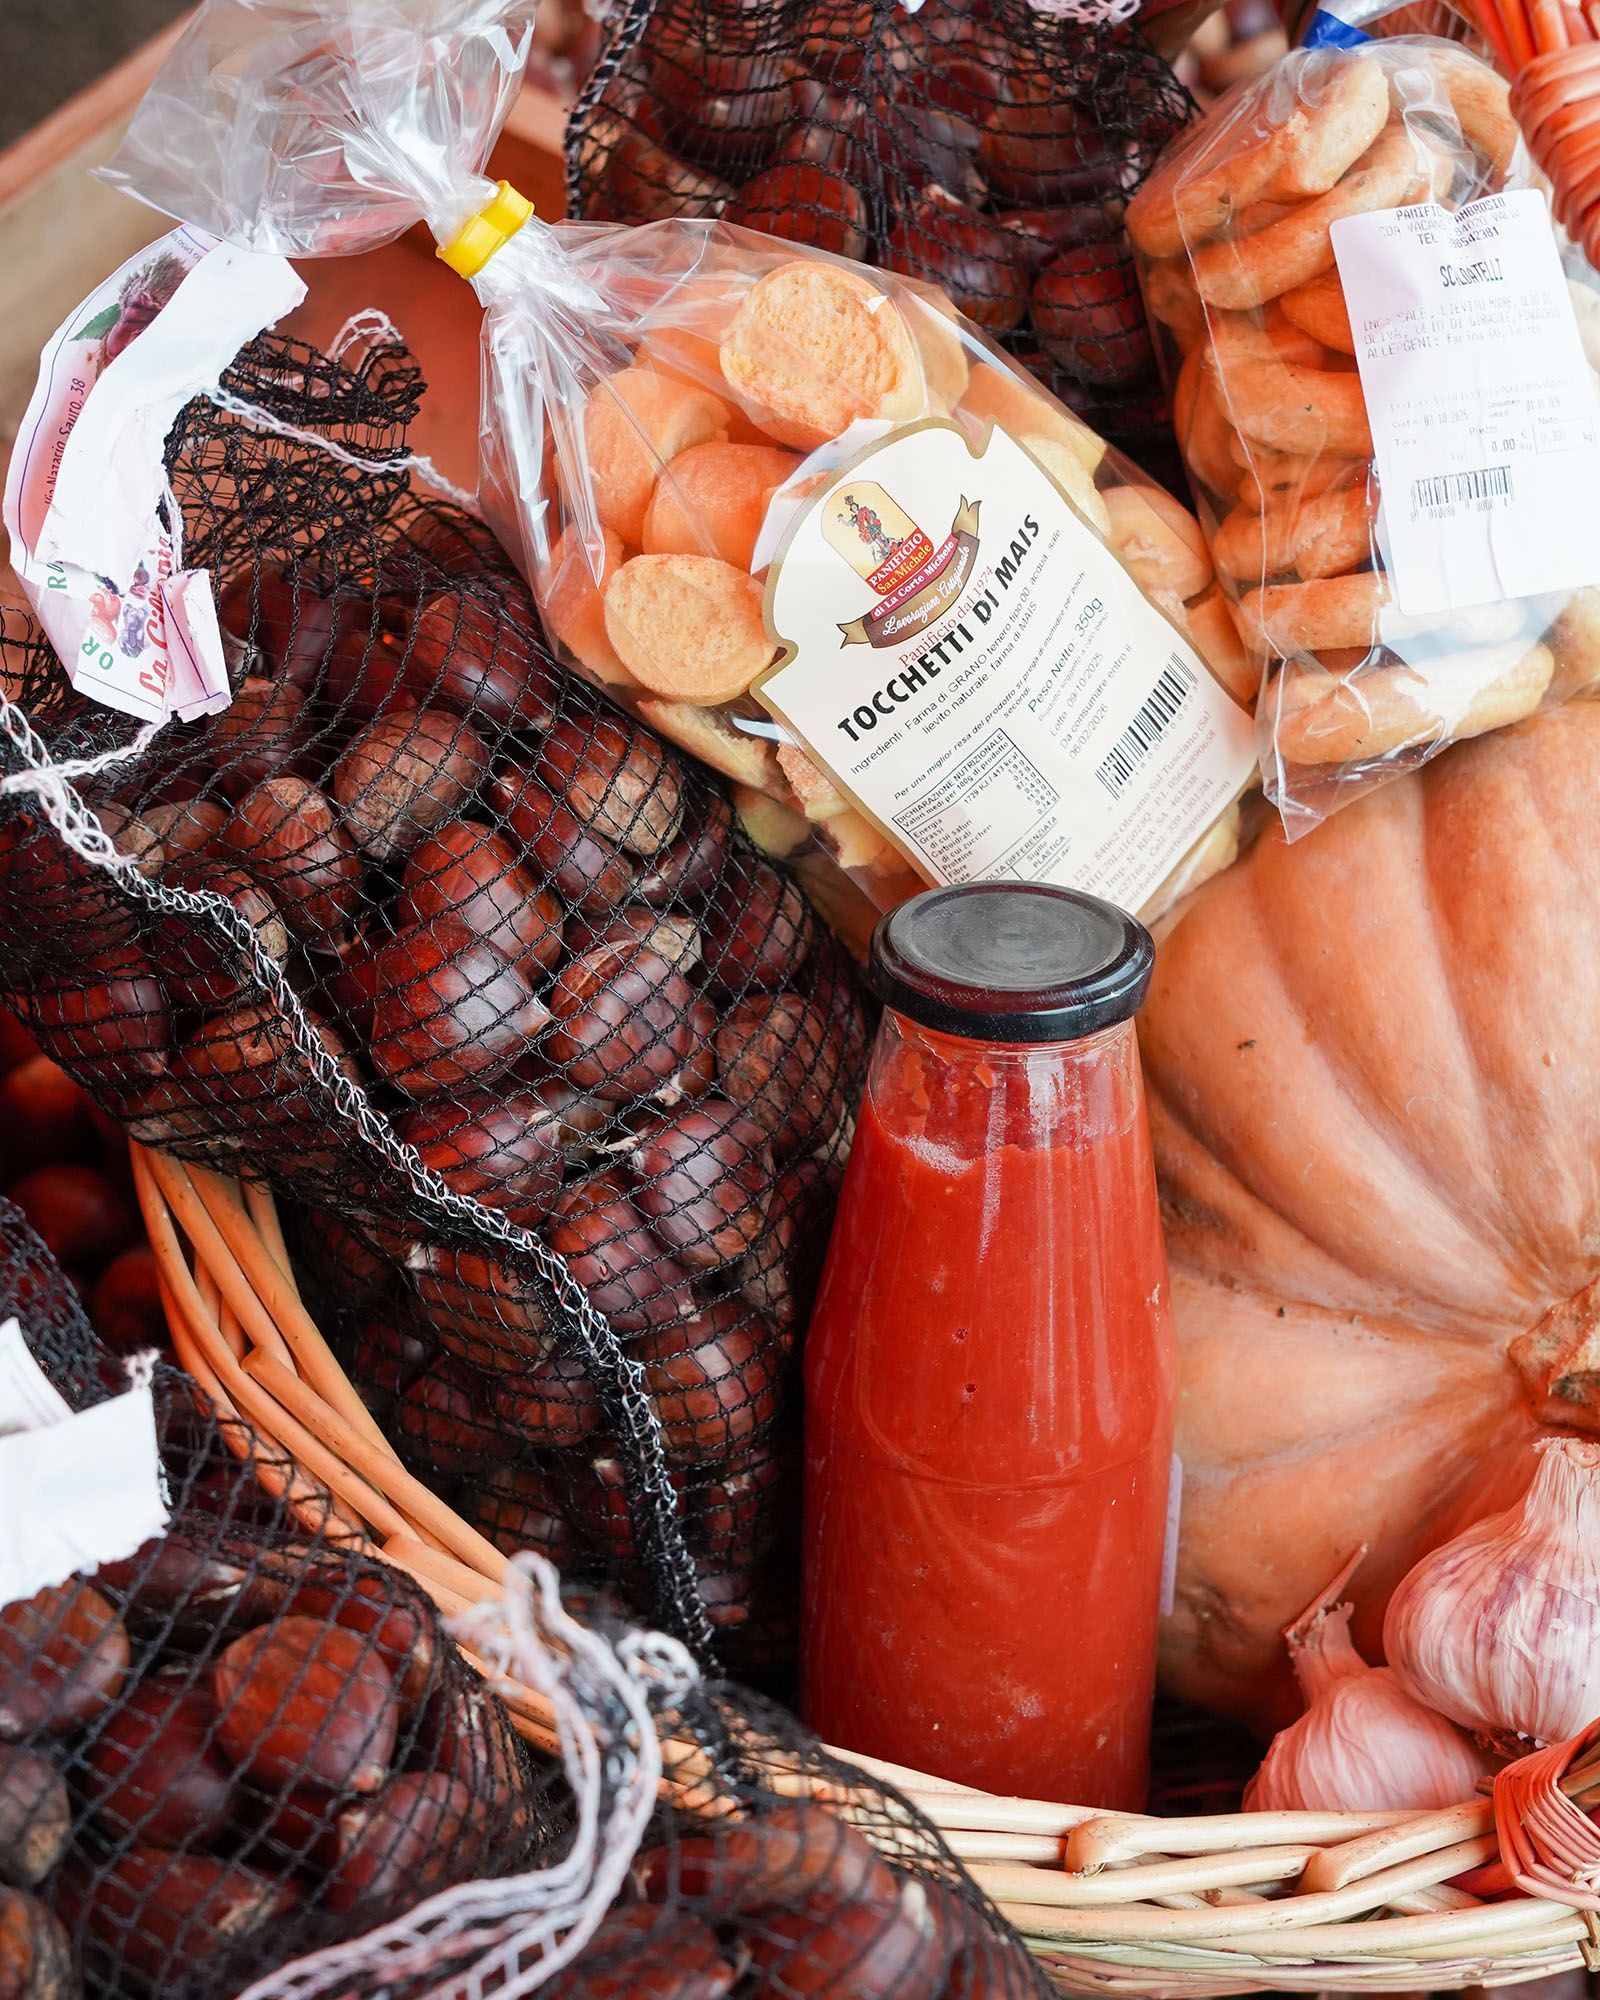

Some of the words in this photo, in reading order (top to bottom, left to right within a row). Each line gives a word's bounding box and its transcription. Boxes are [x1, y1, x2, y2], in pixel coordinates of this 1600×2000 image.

[1396, 205, 1442, 221] PANIFIC
[1454, 196, 1505, 224] AMBROSIO
[1439, 258, 1503, 288] SCLDATELLI
[69, 377, 86, 395] 38
[869, 531, 925, 586] PANIFICIO
[872, 604, 887, 618] di
[884, 594, 900, 609] La
[897, 572, 926, 598] Corte
[923, 539, 956, 577] Michele
[879, 574, 901, 593] San
[895, 542, 934, 579] Michele
[884, 595, 942, 636] Lavorazione
[938, 544, 970, 597] Artigianale
[898, 617, 959, 668] Panificio
[957, 595, 977, 620] dal
[974, 565, 996, 596] 1974
[837, 622, 976, 742] TOCCHETTI
[972, 587, 1001, 626] DI
[995, 513, 1038, 590] MAIS
[1028, 677, 1056, 713] Peso
[1073, 596, 1104, 638] 350g
[904, 700, 939, 730] Farina
[938, 690, 950, 703] di
[947, 652, 990, 694] GRANO
[985, 622, 1014, 655] tenero
[1008, 602, 1025, 623] tipo
[922, 707, 953, 734] lievito
[990, 641, 1016, 671] farina
[1012, 629, 1023, 642] di
[1018, 599, 1039, 631] MAIS
[1066, 649, 1106, 708] 09/10/2025
[1060, 732, 1074, 749] Da
[1070, 677, 1110, 734] consumare
[1107, 651, 1129, 679] entro
[895, 785, 911, 800] Per
[911, 773, 928, 789] una
[927, 749, 954, 775] miglior
[954, 732, 973, 751] resa
[972, 718, 986, 734] del
[985, 687, 1018, 724] prodotto
[1022, 655, 1040, 682] prega
[897, 778, 955, 824] DICHIARAZIONE
[954, 733, 1005, 782] NUTRIZIONALE
[903, 810, 927, 828] Valori
[926, 798, 946, 814] medi
[944, 789, 958, 803] per
[956, 774, 975, 790] 100g
[972, 766, 982, 776] di
[980, 740, 1010, 771] prodotto
[964, 788, 981, 805] 1729
[992, 764, 1006, 779] 413
[1003, 751, 1020, 767] kcal
[1117, 791, 1153, 834] Olevano
[1148, 772, 1165, 793] Sul
[913, 817, 944, 839] Energia
[919, 826, 945, 845] Grassi
[930, 840, 940, 849] di
[939, 832, 952, 844] cui
[931, 829, 973, 858] Carboidrati
[941, 854, 951, 862] di
[950, 846, 964, 858] cui
[1005, 815, 1058, 866] DIFFERENZIATA
[1026, 839, 1049, 861] Sigillo
[1033, 834, 1067, 868] PLASTICA
[1123, 779, 1232, 909] michelelacorte@gmail.com
[943, 848, 975, 871] Proteine
[947, 863, 969, 878] Fibre
